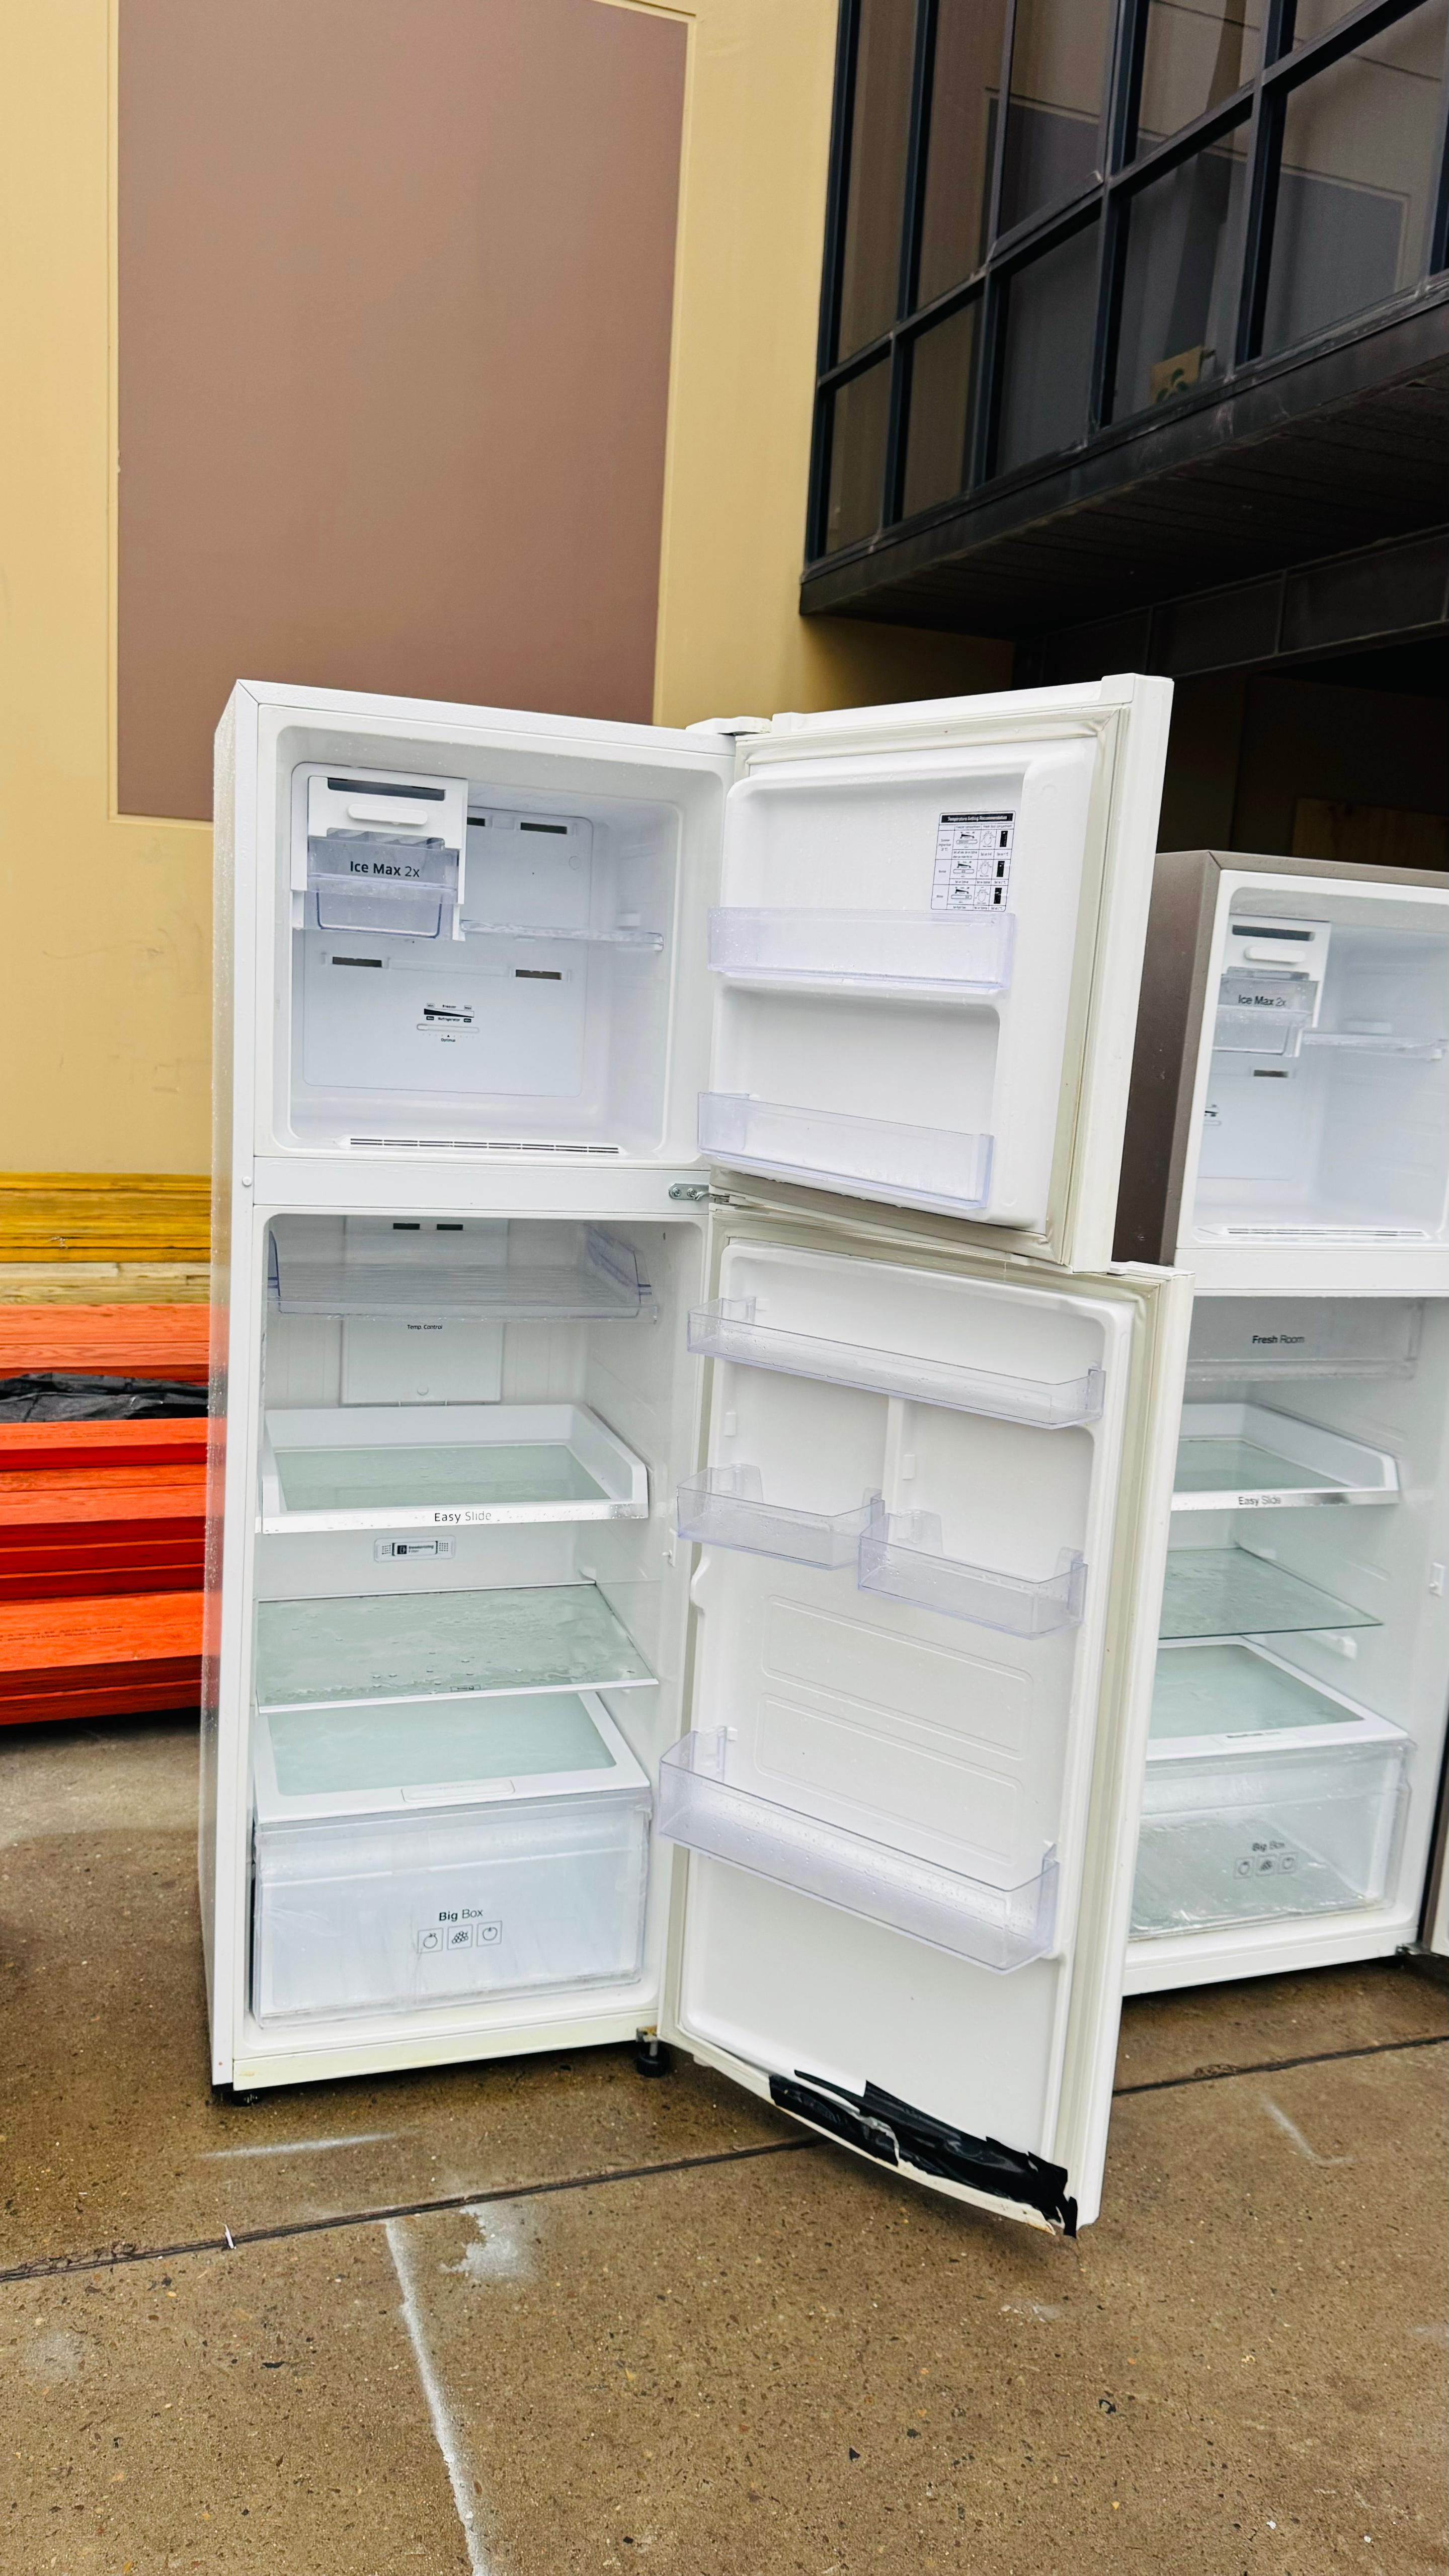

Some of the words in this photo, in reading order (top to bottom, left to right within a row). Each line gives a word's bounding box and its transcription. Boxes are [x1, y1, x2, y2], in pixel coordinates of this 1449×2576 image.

[350, 861, 369, 872] Ice
[373, 863, 401, 876] Max
[405, 866, 420, 877] 2x
[1238, 995, 1252, 1005] Ice
[1254, 996, 1274, 1006] Max
[1276, 997, 1286, 1006] 2x
[1252, 1335, 1277, 1344] Fresh
[1279, 1335, 1305, 1343] Room
[1238, 1496, 1259, 1506] Easy
[1261, 1495, 1281, 1505] Slide
[434, 1512, 461, 1523] Easy
[465, 1511, 492, 1521] Slide
[439, 1911, 458, 1921] Big
[462, 1909, 484, 1919] Box
